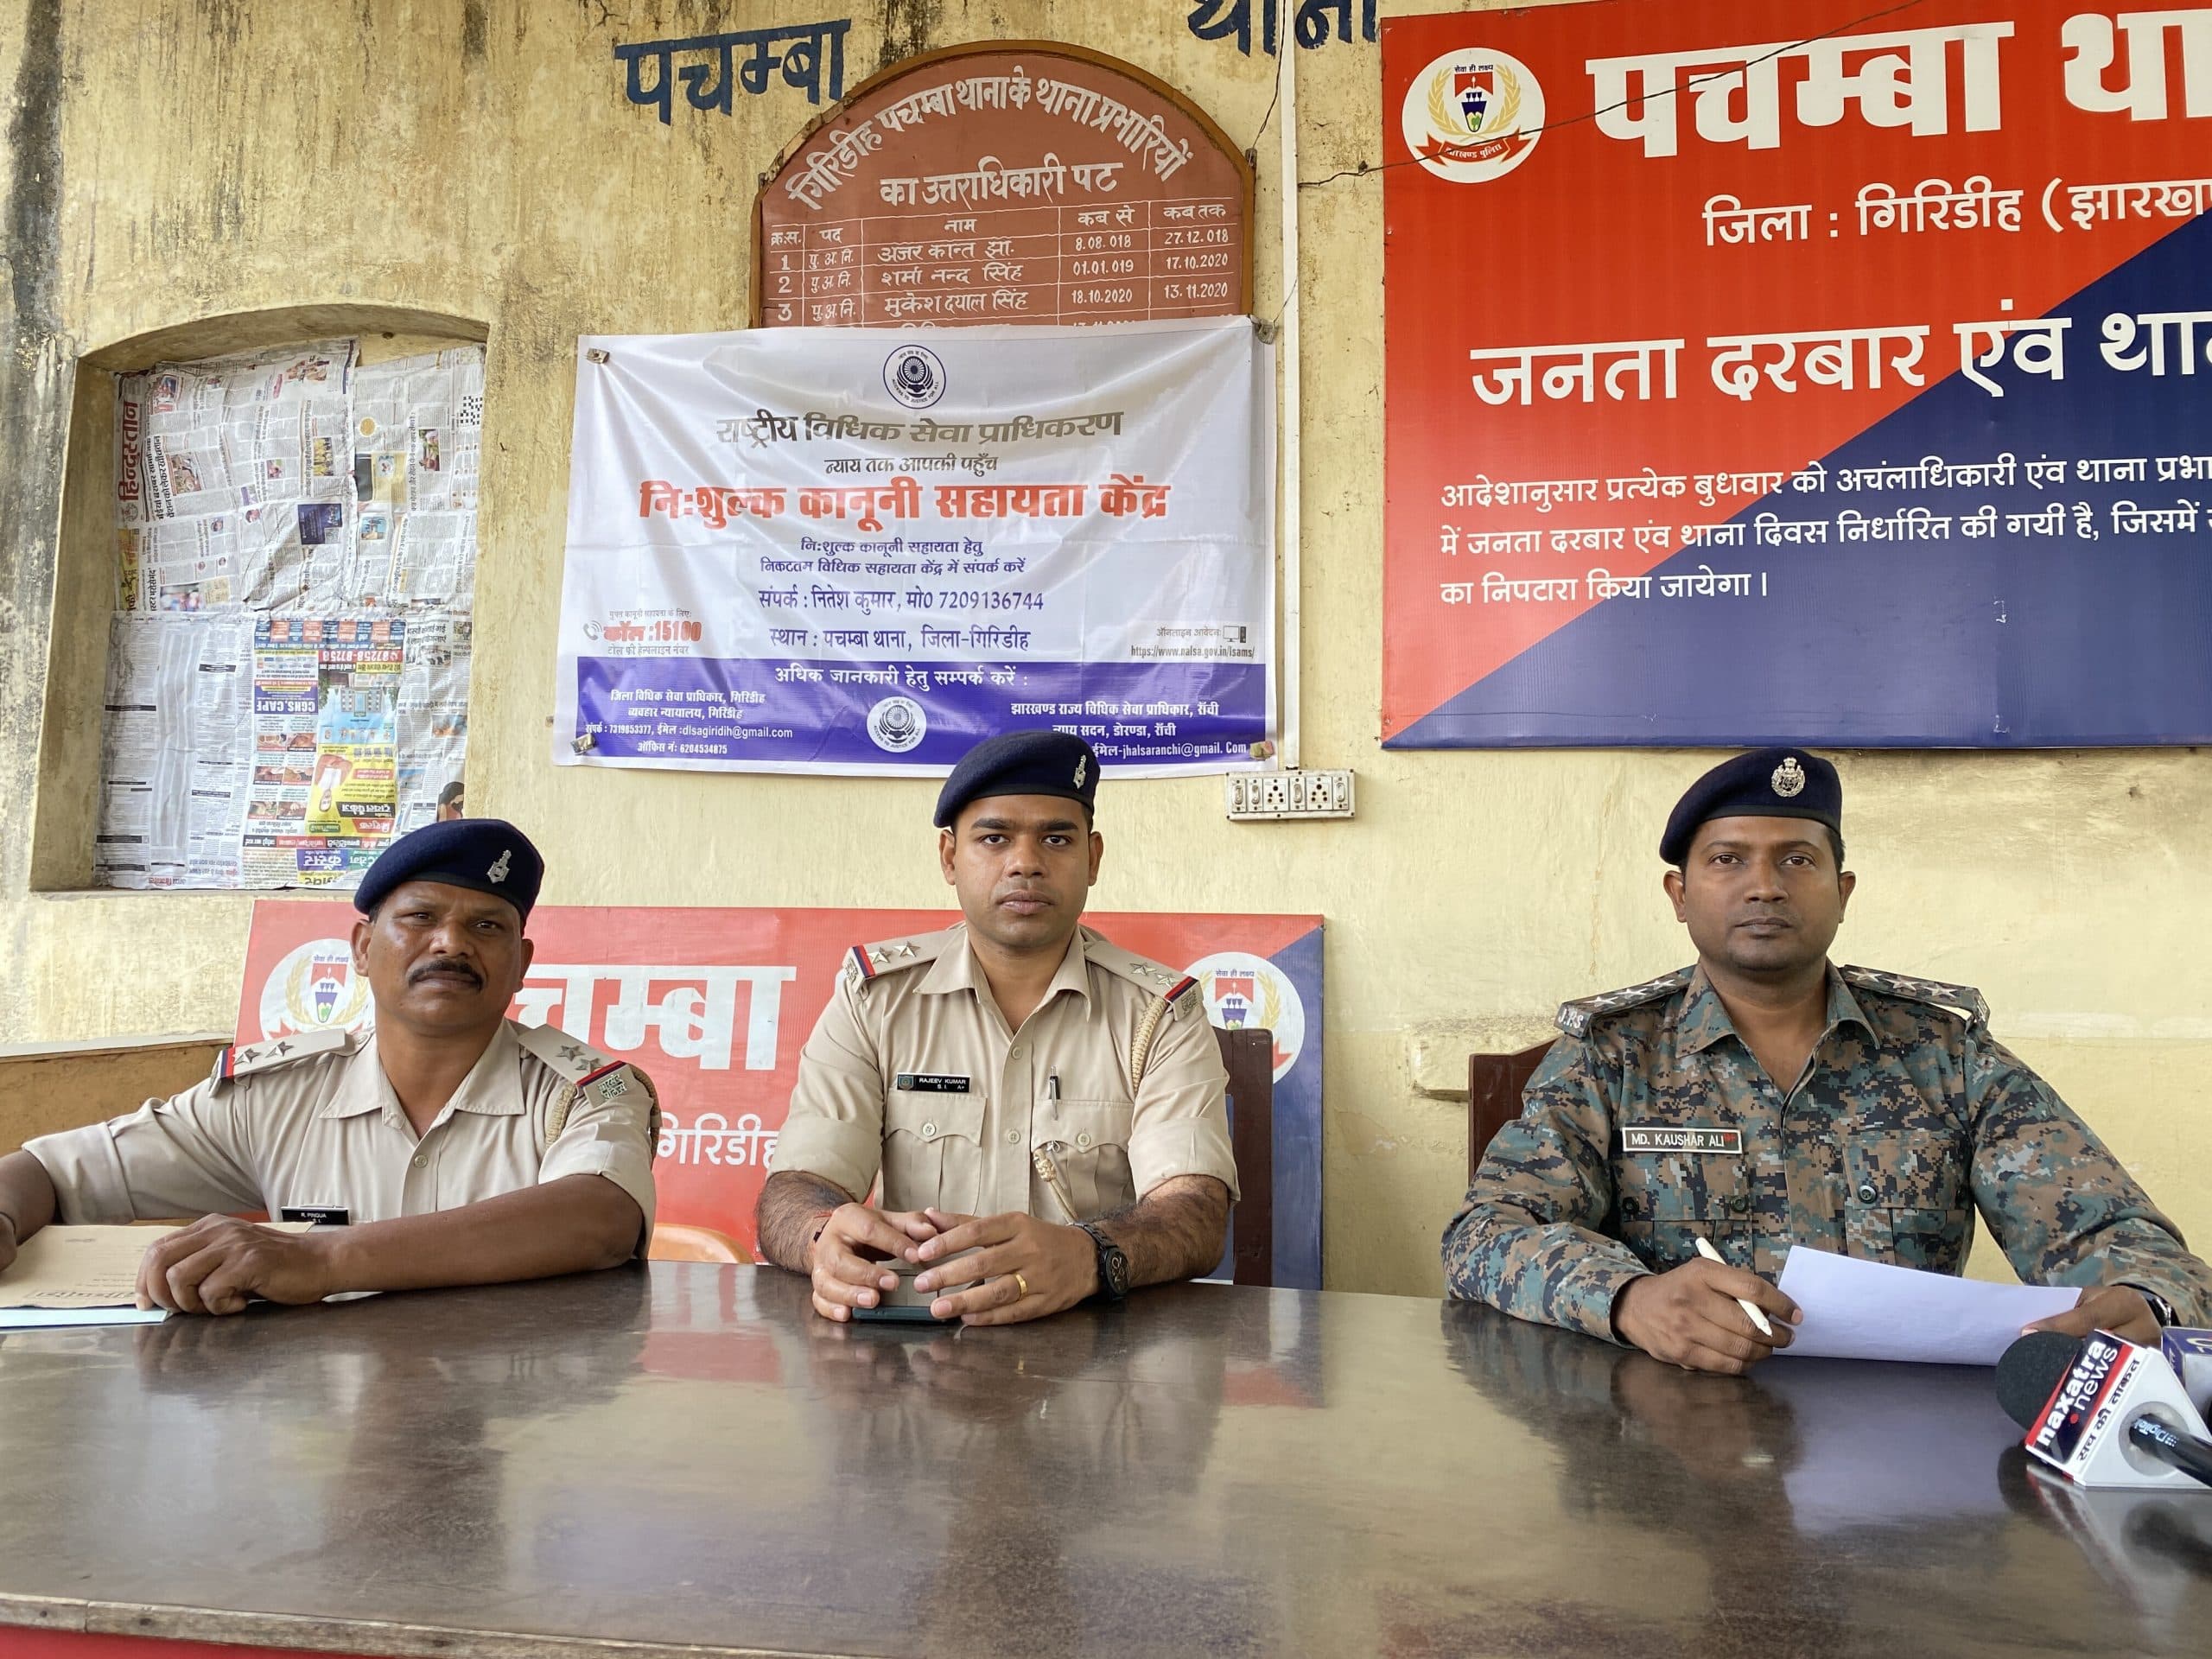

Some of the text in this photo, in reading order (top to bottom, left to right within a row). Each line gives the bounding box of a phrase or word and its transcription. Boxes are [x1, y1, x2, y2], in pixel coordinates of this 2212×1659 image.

[614, 19, 851, 126] पचम्बा
[1454, 64, 1467, 73] सेवा
[1586, 21, 2014, 158] पचम्बा
[785, 120, 883, 210] गिरिडीह
[874, 83, 957, 133] पचम्बा
[1036, 78, 1102, 127] थाना
[1090, 94, 1194, 182] प्रभारियों
[880, 152, 1124, 211] का उत्तराधिकारी पट
[819, 204, 1226, 244] पद नाम कब से कब तक
[1702, 194, 1812, 246] जिला
[1856, 175, 2024, 238] गिरिडीह
[779, 276, 792, 294] 2
[880, 267, 923, 287] शर्मा
[931, 268, 972, 284] नन्द
[982, 260, 1024, 282] सिंह
[1166, 252, 1229, 270] 17.10.2020
[781, 255, 791, 271] 1
[928, 242, 976, 260] कान्त
[778, 282, 1228, 322] 3 मुकेश दयाल सिंह 18.10.2020 13.11.2020
[1471, 338, 1684, 406] जनता
[1707, 324, 1929, 402] दरबार
[2101, 311, 2212, 377] था
[716, 408, 1124, 449] राष्ट्रीय विधिक सेवा प्राधिकरण
[823, 457, 861, 474] न्याय
[865, 456, 894, 473] तक
[899, 453, 957, 473] आपकी
[797, 475, 924, 532] कानूनी
[934, 484, 1089, 518] सहायता
[1098, 474, 1172, 519] केंद्र
[1440, 474, 1599, 513] आदेशानुसार
[1606, 467, 1687, 501] प्रत्येक
[1694, 472, 1784, 507] बुधवार
[1791, 461, 1827, 493] को
[2076, 458, 2148, 483] थाना
[860, 537, 904, 558] कानूनी
[908, 541, 959, 554] सहायता
[963, 536, 984, 556] हेतु
[1440, 524, 1462, 556] में
[1467, 531, 1542, 554] जनता
[1550, 527, 1625, 554] दरबार
[1681, 523, 1746, 547] थाना
[1754, 512, 1829, 547] दिवस
[1836, 506, 1953, 543] निर्धारित
[1960, 505, 1999, 539] की
[2005, 502, 2067, 537] गयी
[2071, 501, 2100, 541] है,
[2111, 499, 2201, 535] जिसमें
[760, 556, 1027, 575] निकटतम विधिक सहायता केंद्र में संपर्क करें
[1440, 564, 1751, 605] का निपटारा किया जायेगा
[759, 583, 1045, 615] संपर्क नितेश कुमार, 7209136744
[768, 624, 1033, 652] स्थान पचम्बा थाना, जिला-गिरिडीह
[610, 690, 633, 702] जिला
[635, 689, 663, 702] विधिक
[665, 690, 683, 702] सेवा
[729, 690, 766, 704] गिरिडीह
[775, 663, 1017, 692] अधिक जानकारी हेतु सम्पर्क करें
[708, 707, 744, 719] गिरिडीह
[1010, 702, 1056, 715] झारखण्ड
[1058, 702, 1081, 715] राज्य
[1085, 701, 1119, 715] विधिक
[1122, 701, 1142, 715] सेवा
[514, 964, 797, 1071] चम्बा
[1631, 1133, 1651, 1146] MD.
[1655, 1133, 1705, 1147] KAUSHAR
[1708, 1135, 1726, 1147] ALI
[2036, 1340, 2107, 1448] naxatra
[2074, 1346, 2118, 1412] news
